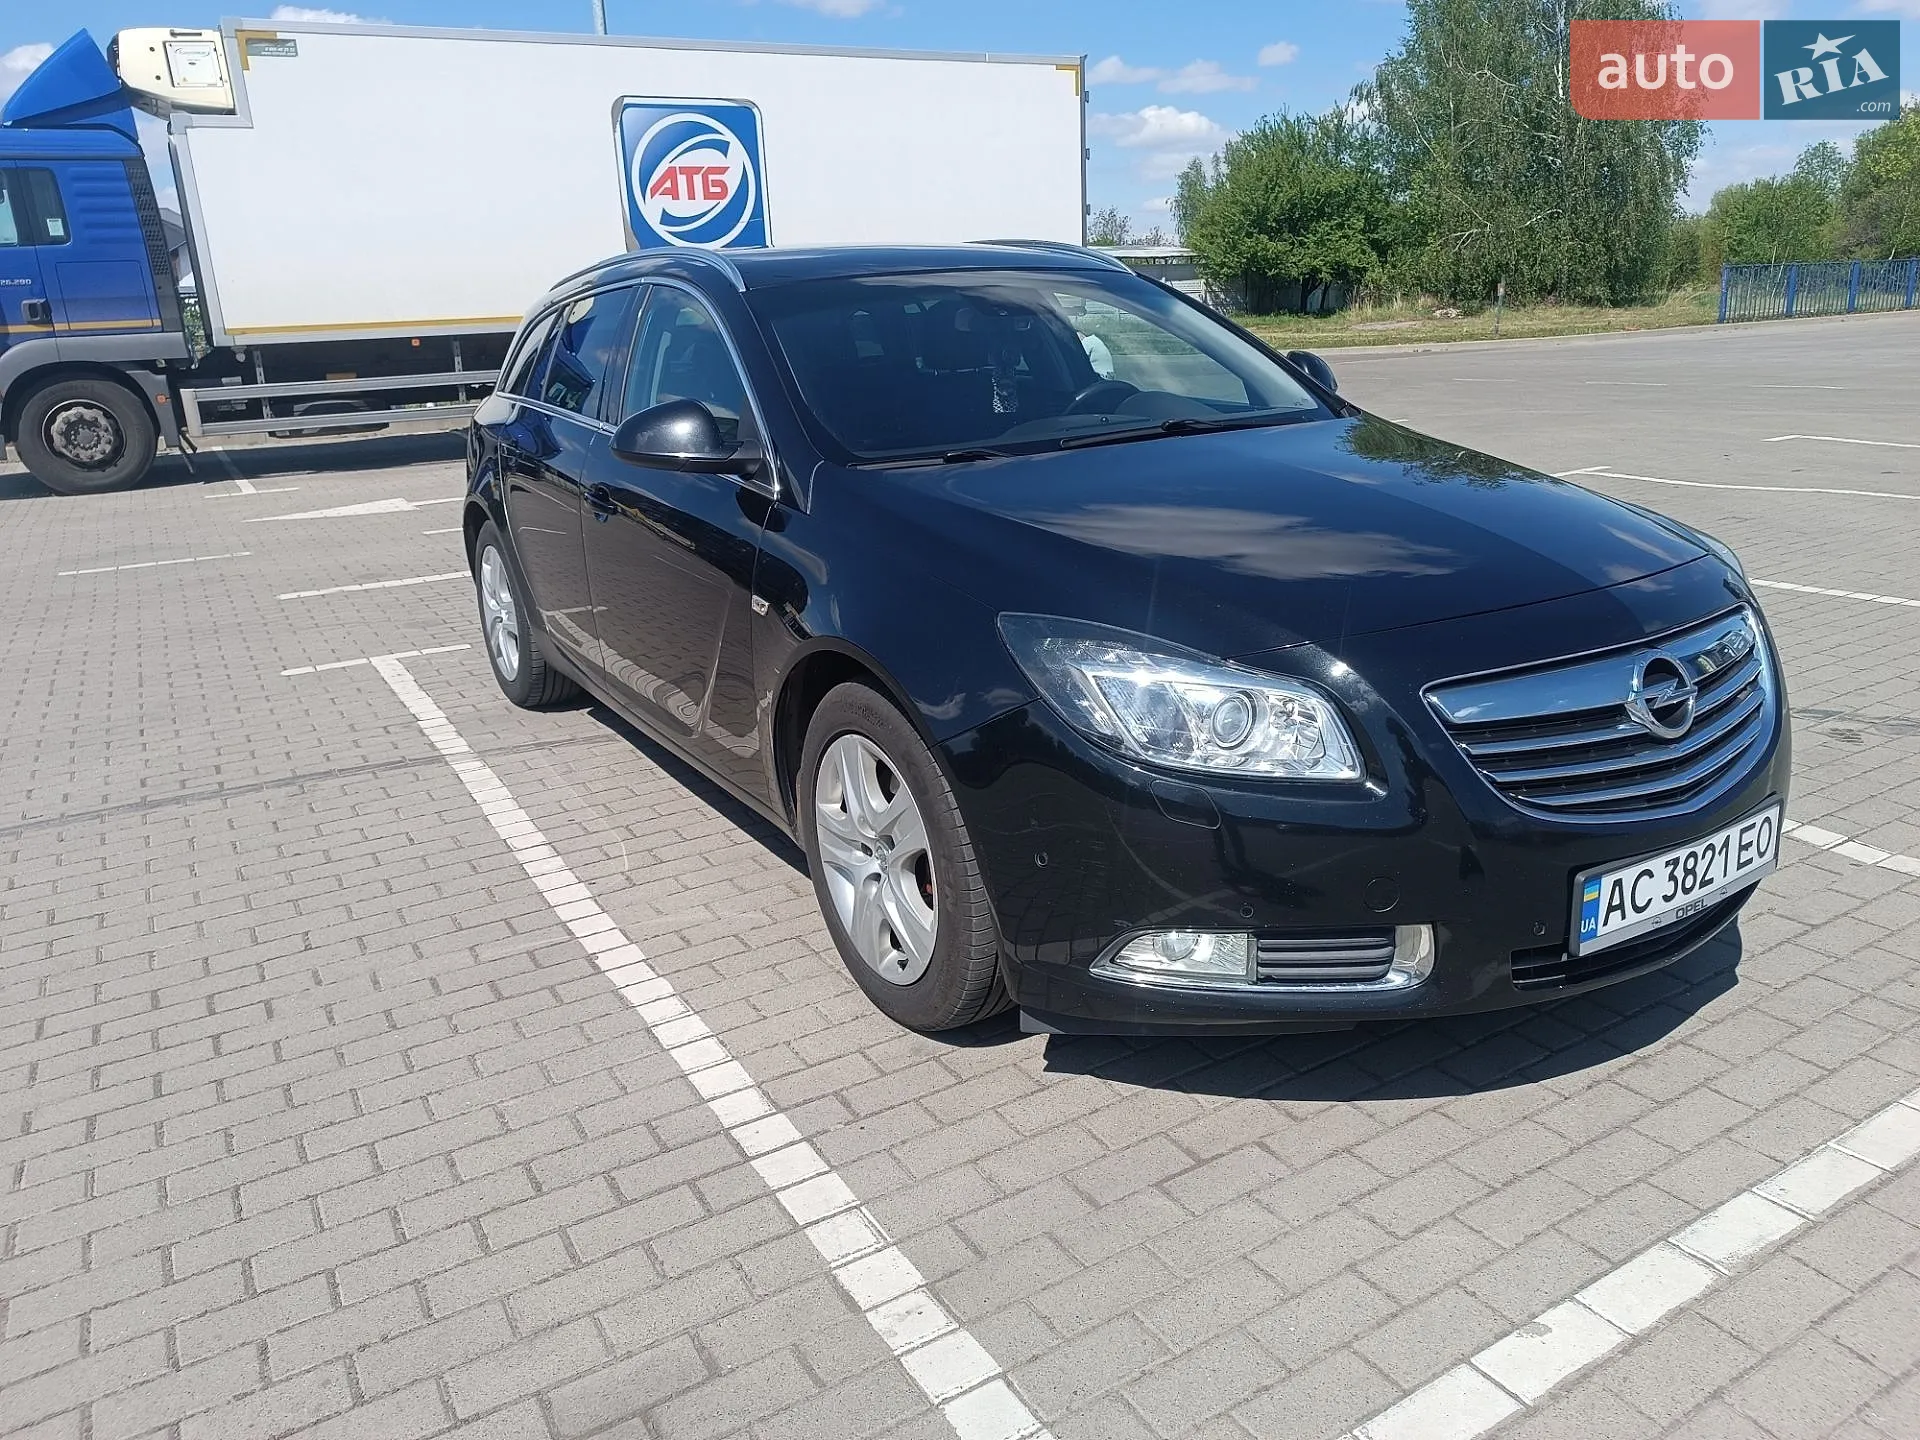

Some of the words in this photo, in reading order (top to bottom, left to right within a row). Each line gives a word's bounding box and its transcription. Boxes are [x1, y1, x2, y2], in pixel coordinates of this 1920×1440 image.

[650, 166, 730, 200] АТБ
[1602, 868, 1655, 927] AC
[1662, 834, 1731, 904] 3821
[1737, 816, 1772, 871] EO
[1675, 898, 1708, 920] OPEL
[1581, 919, 1596, 933] UA
